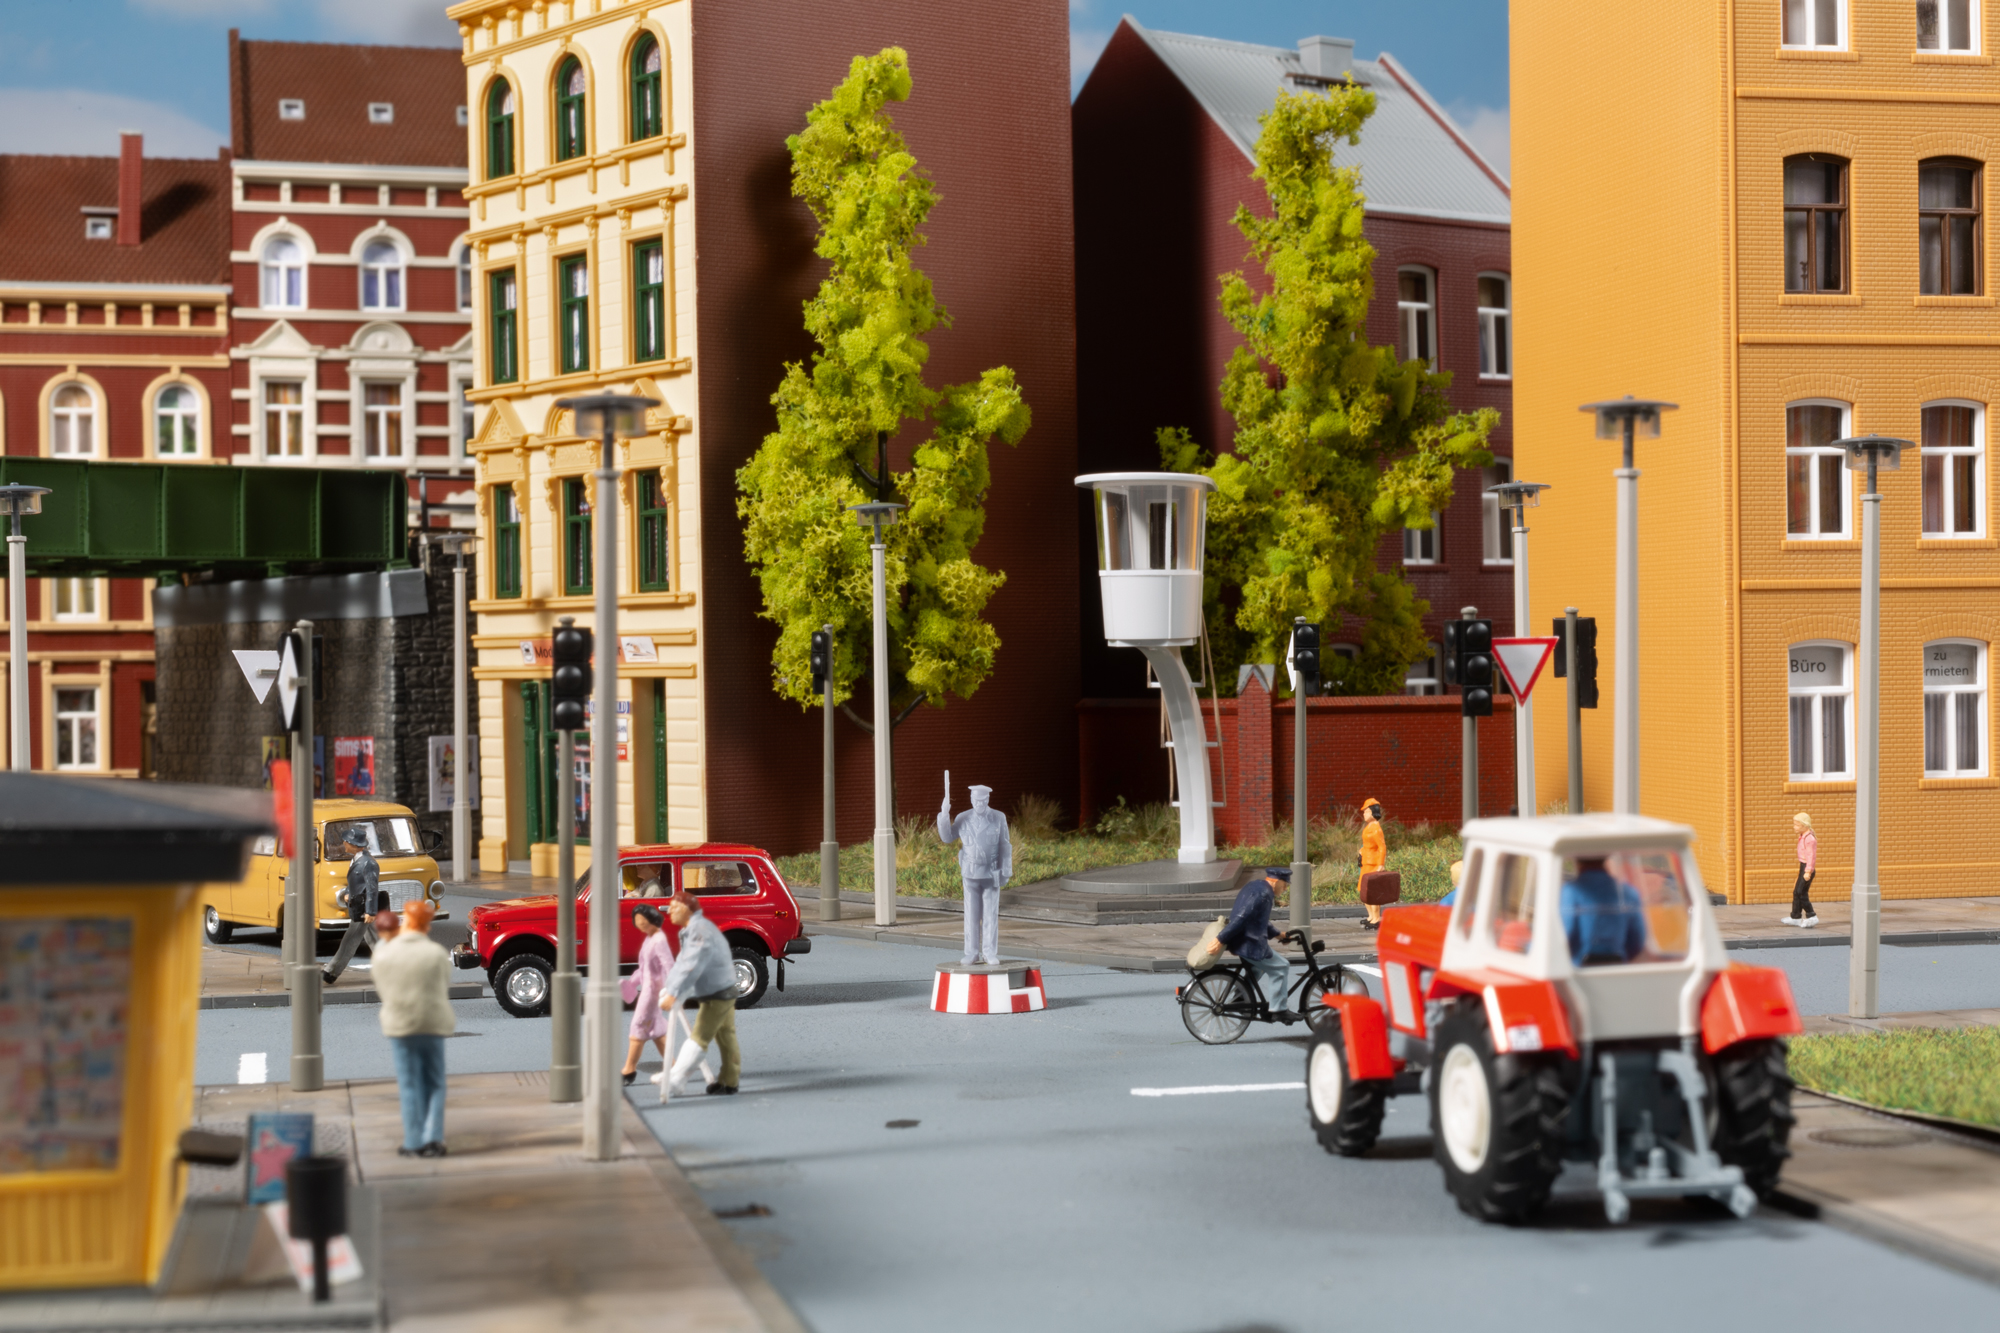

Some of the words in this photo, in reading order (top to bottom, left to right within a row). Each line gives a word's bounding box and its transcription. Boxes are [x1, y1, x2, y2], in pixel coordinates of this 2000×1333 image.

[1933, 652, 1947, 661] zu
[1790, 659, 1827, 673] Büro
[1924, 665, 1969, 677] rmieten
